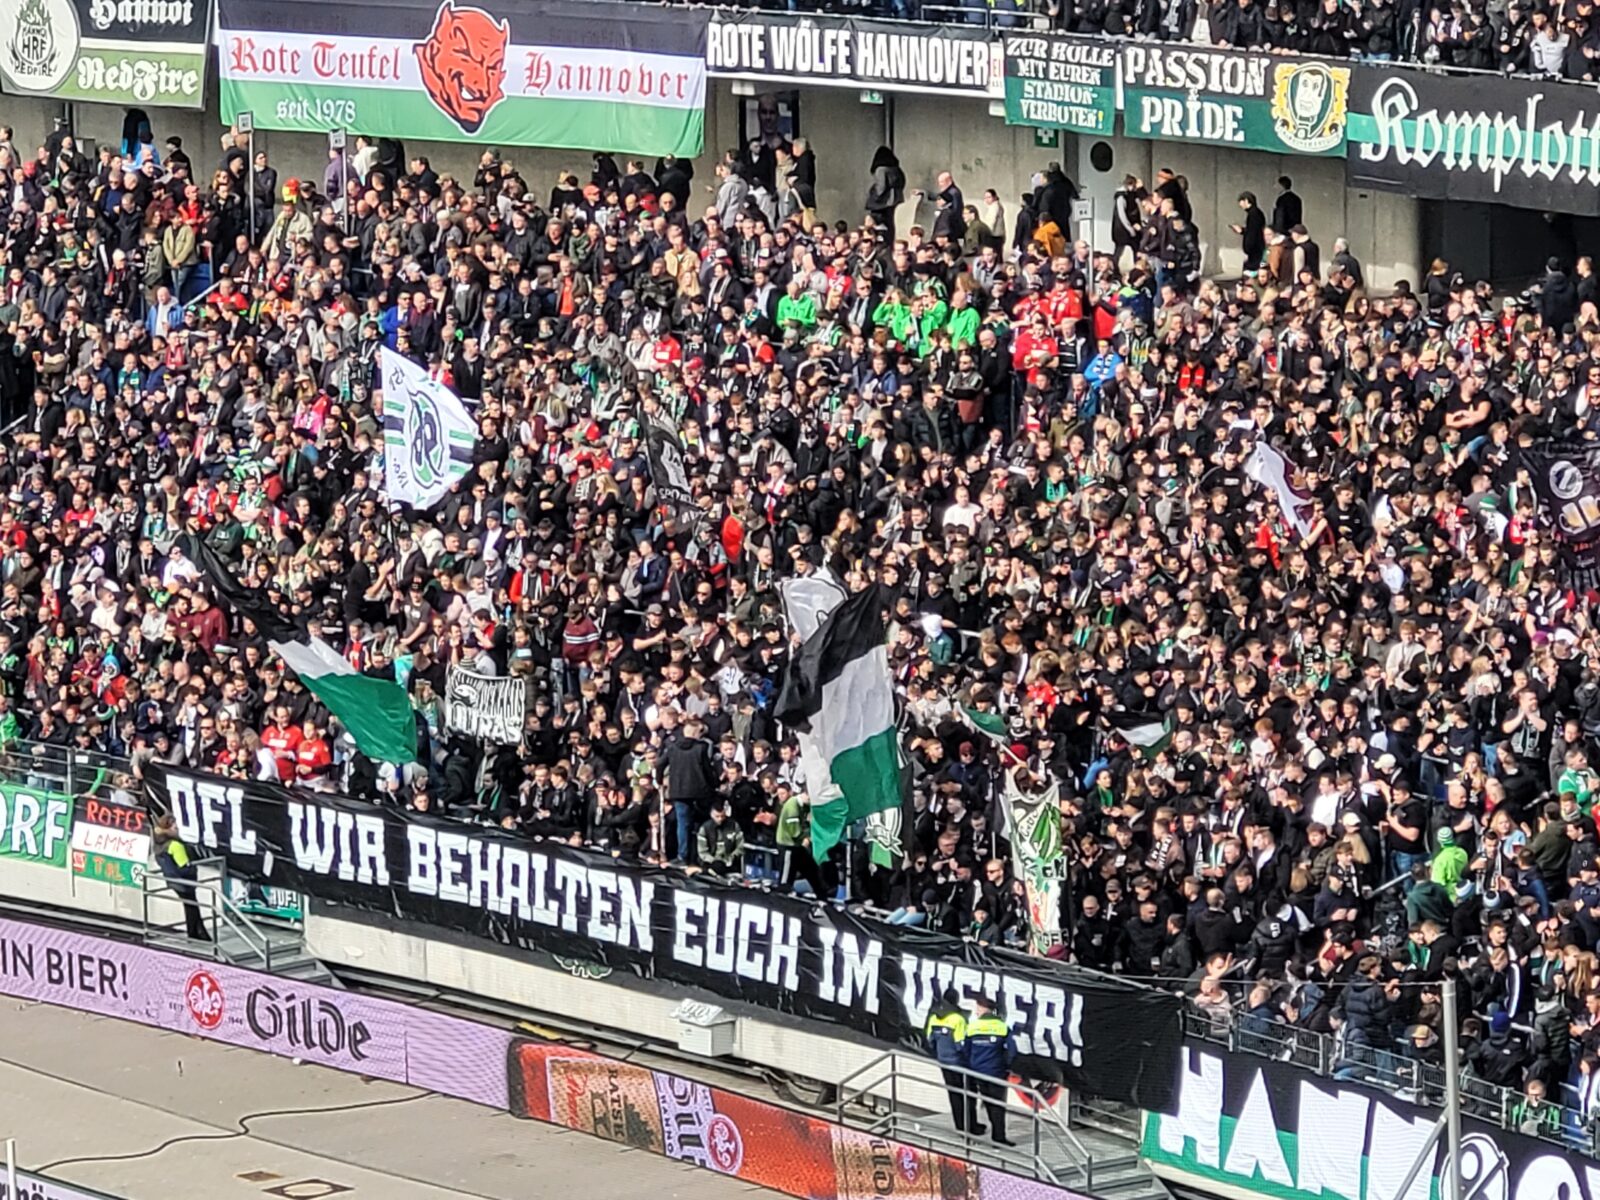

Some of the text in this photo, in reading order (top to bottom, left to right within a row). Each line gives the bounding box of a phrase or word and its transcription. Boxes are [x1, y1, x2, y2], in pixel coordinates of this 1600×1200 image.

[22, 36, 47, 60] HRF
[230, 37, 401, 80] Rote Teufel
[707, 20, 989, 86] ROTE WÖLFE HANNOVER
[1006, 38, 1048, 59] ZUR
[1125, 46, 1271, 96] PASSION
[78, 56, 198, 100] RedFire
[523, 51, 689, 99] Hannover
[1017, 58, 1046, 78] MIT
[1049, 61, 1102, 86] EUREN
[276, 97, 356, 124] seit 1978
[1140, 96, 1246, 142] PRIDE
[1359, 76, 1600, 193] Komplott
[0, 791, 68, 860] RF
[85, 800, 146, 831] ROTES
[288, 802, 390, 886] WIR
[407, 824, 655, 952] BEHALTEN
[673, 889, 802, 992] EUCH
[819, 926, 883, 1015] IM
[46, 947, 129, 1001] BIER!
[246, 985, 372, 1062] Gilde
